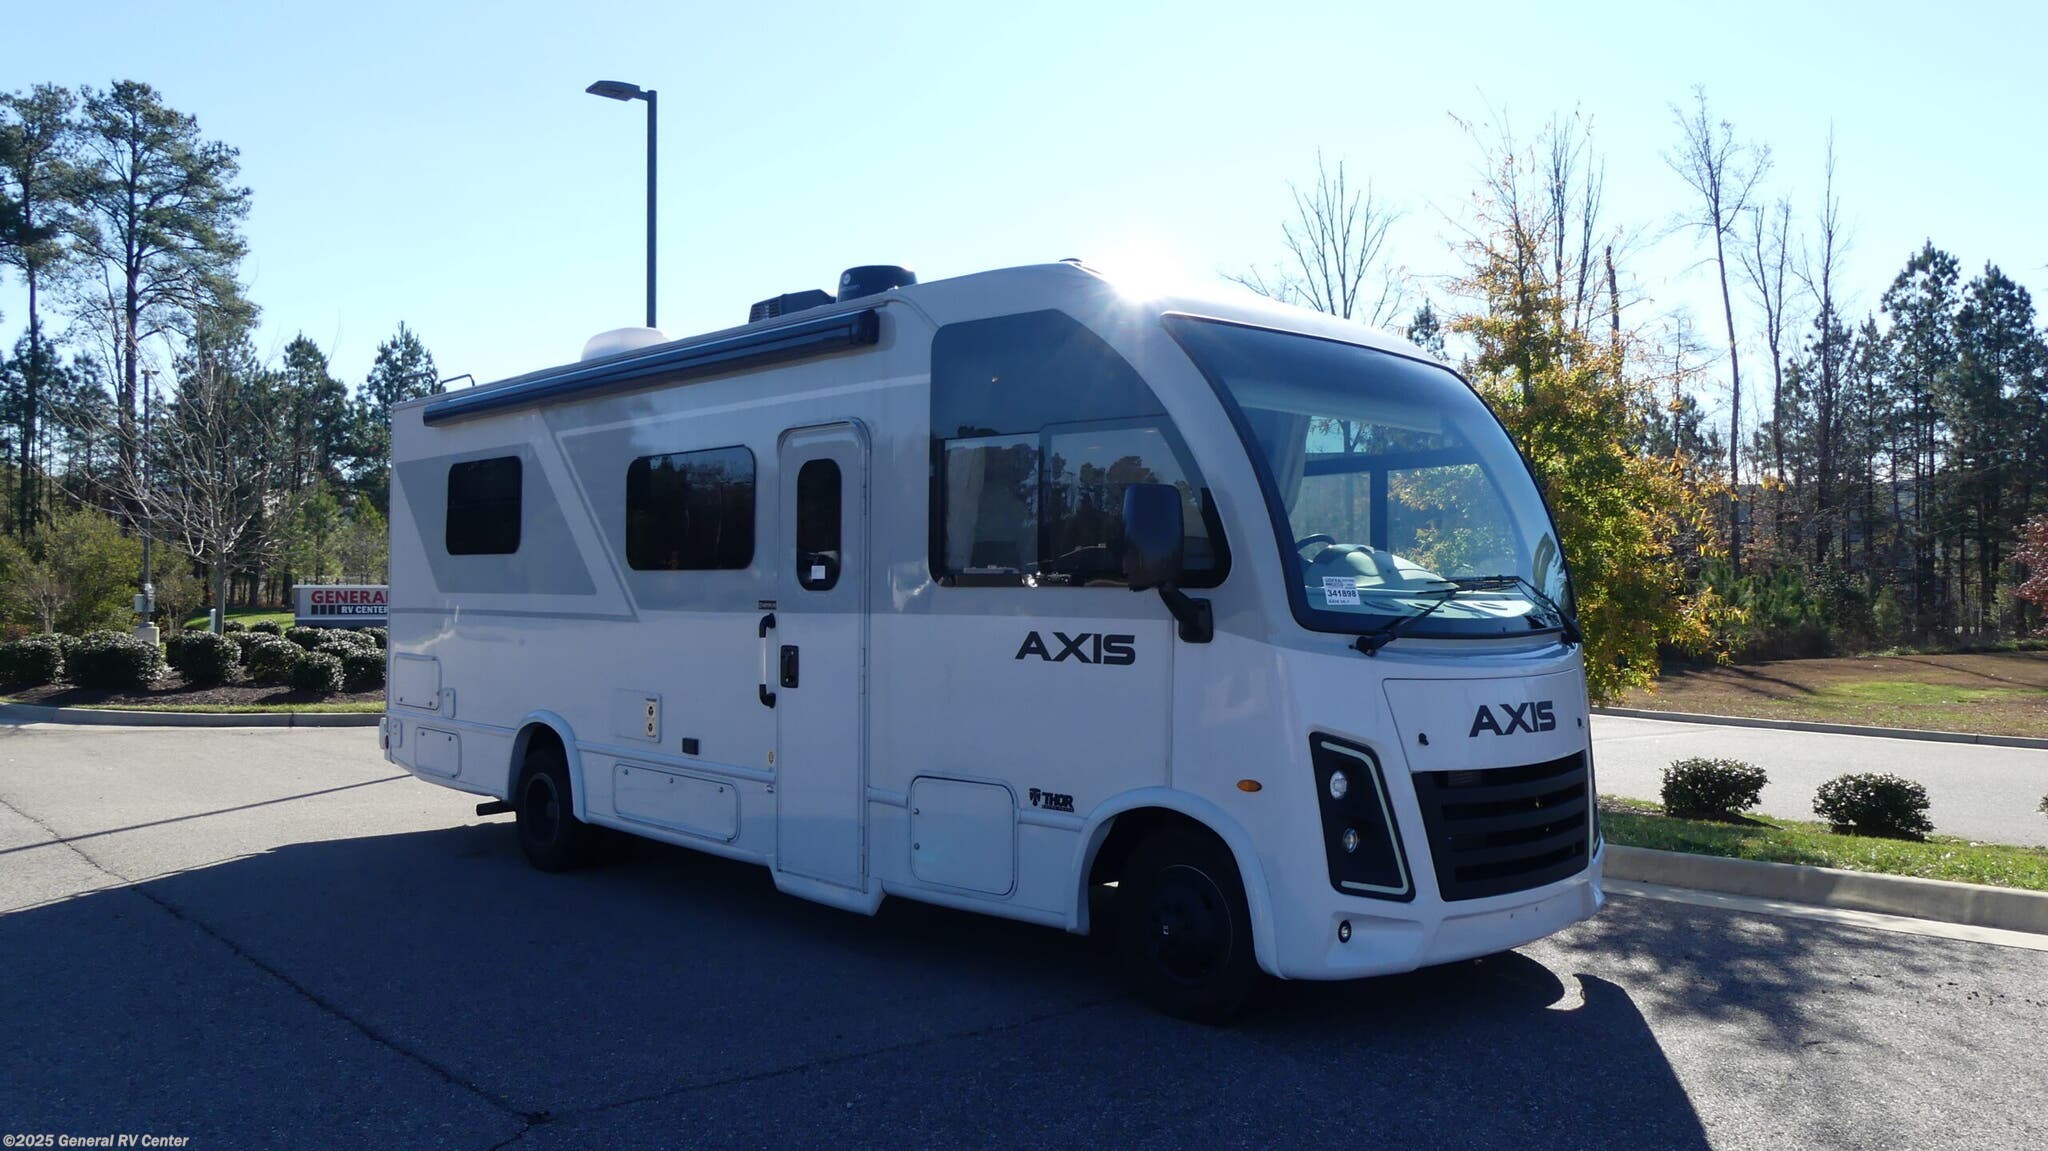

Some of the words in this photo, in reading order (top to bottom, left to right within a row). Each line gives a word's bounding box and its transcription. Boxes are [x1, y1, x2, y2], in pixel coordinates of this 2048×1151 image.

[1326, 590, 1357, 598] 341898
[341, 606, 354, 614] RV
[1015, 631, 1136, 665] AXIS
[1469, 700, 1556, 737] AXIS
[1041, 792, 1074, 808] THOR
